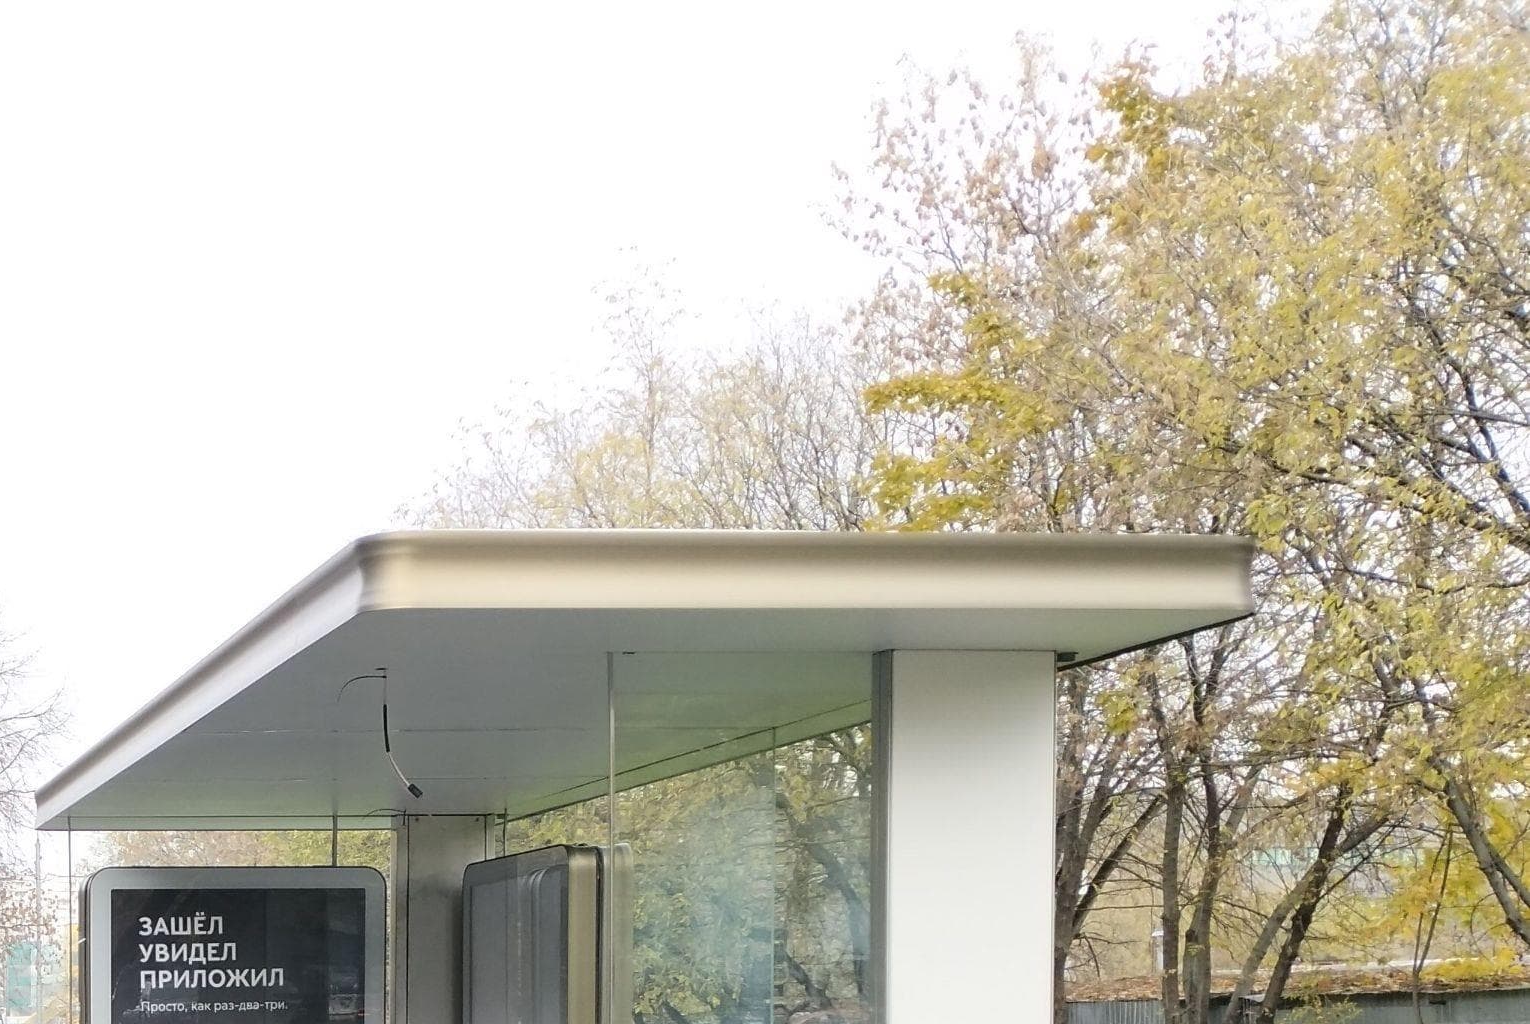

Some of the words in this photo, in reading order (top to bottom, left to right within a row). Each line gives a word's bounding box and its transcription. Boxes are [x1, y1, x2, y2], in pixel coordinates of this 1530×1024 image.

[138, 911, 223, 936] ЗАШЁЛ
[138, 942, 237, 965] УВИДЕЛ
[140, 967, 284, 989] ПРИЛОЖИЛ
[141, 1001, 188, 1014] Просто,
[191, 1002, 211, 1012] как
[214, 1000, 288, 1014] раз-два-три.
